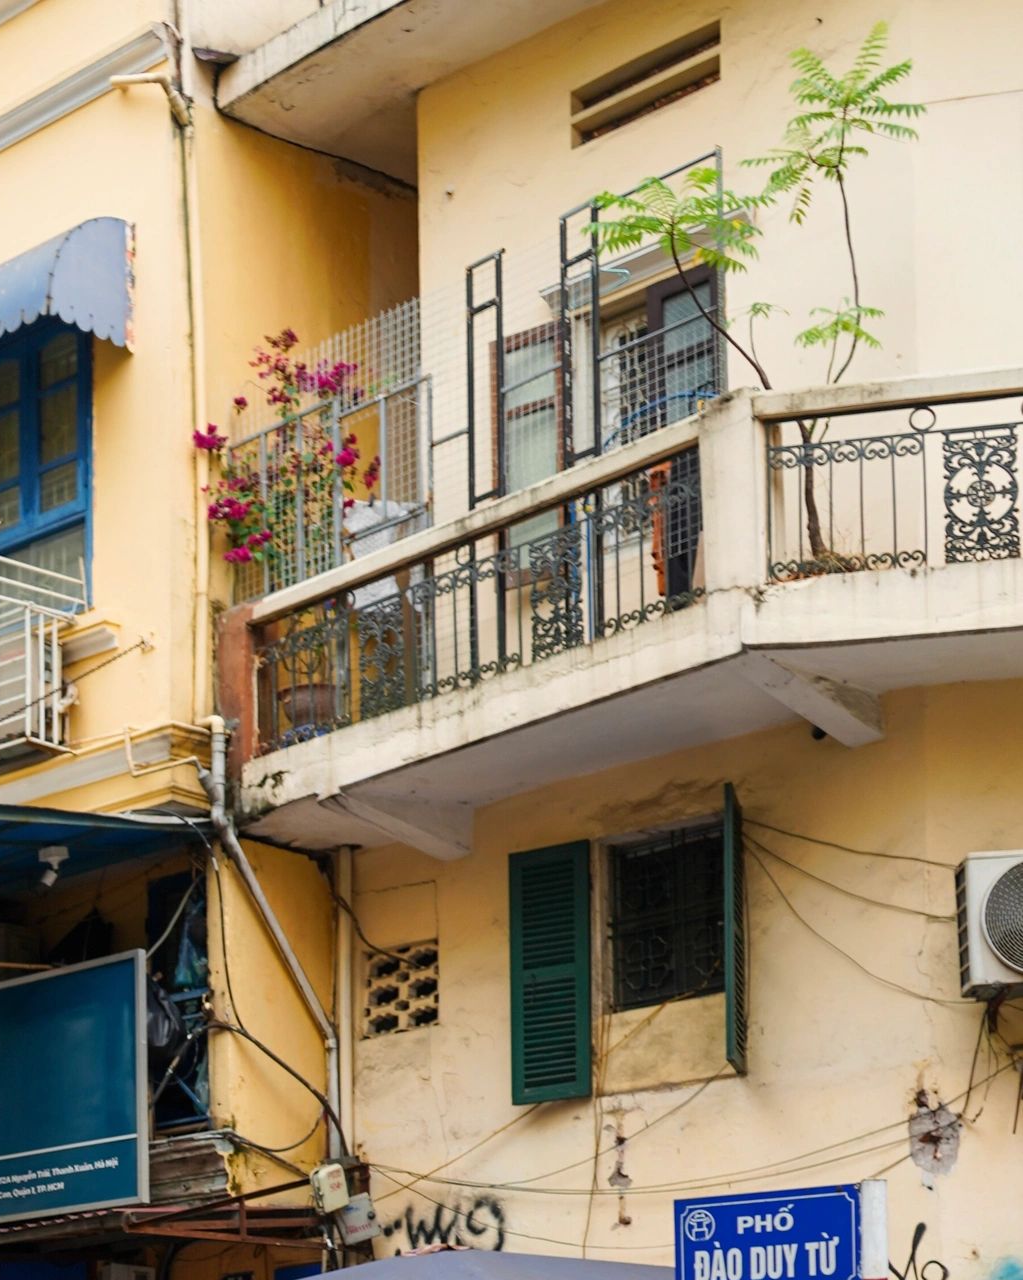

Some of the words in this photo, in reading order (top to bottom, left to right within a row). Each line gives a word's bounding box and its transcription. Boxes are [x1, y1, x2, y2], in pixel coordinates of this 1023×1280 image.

[737, 1204, 794, 1234] PHỐ
[750, 1244, 798, 1280] DUY
[805, 1232, 839, 1276] TỪ
